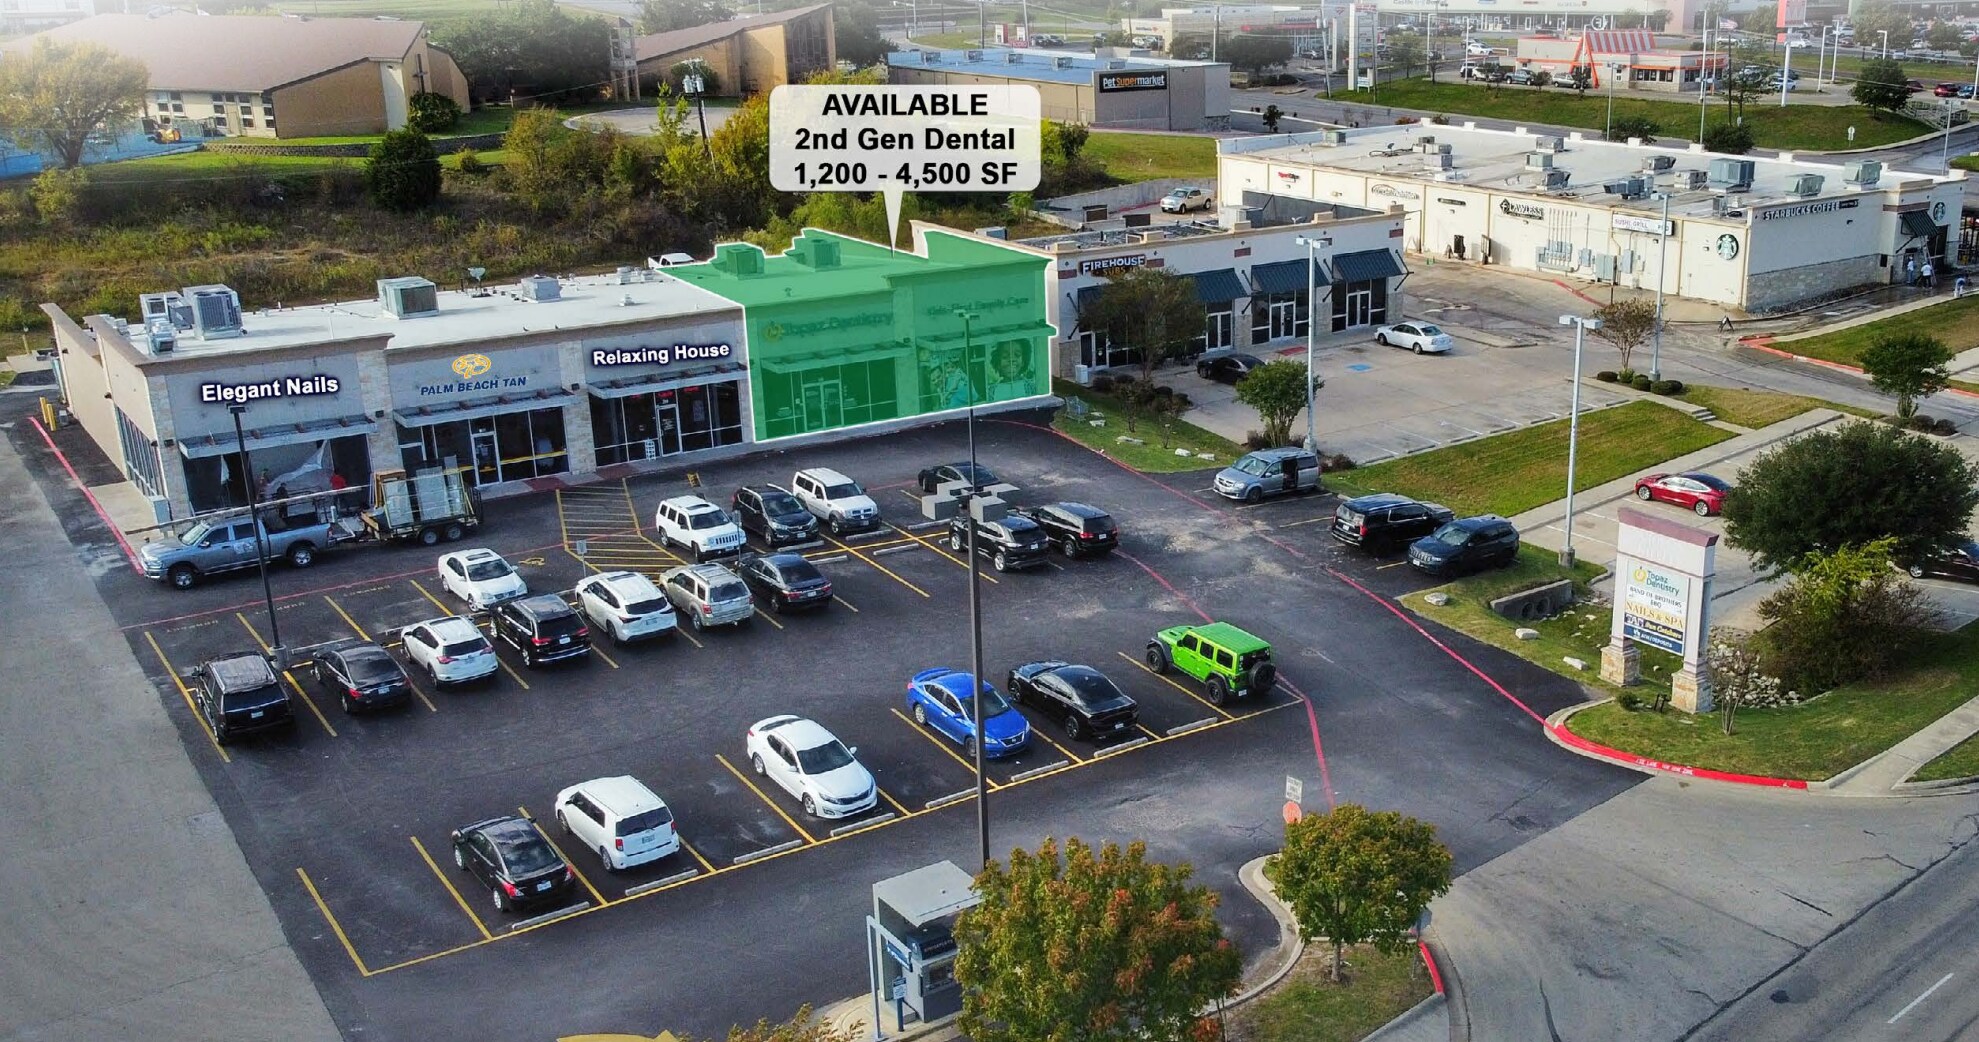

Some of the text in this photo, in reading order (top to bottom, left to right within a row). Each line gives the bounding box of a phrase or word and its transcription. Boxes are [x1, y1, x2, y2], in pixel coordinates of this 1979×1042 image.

[1764, 206, 1811, 220] STARBUCKS
[1811, 201, 1840, 214] COFFEE
[1082, 255, 1145, 275] FIREHOUSE
[420, 376, 527, 396] PALM BEACH TAN
[1647, 570, 1668, 584] Topaz
[1646, 578, 1680, 596] Dentistry
[1626, 601, 1655, 618] NAILS
[1664, 615, 1684, 629] SPA
